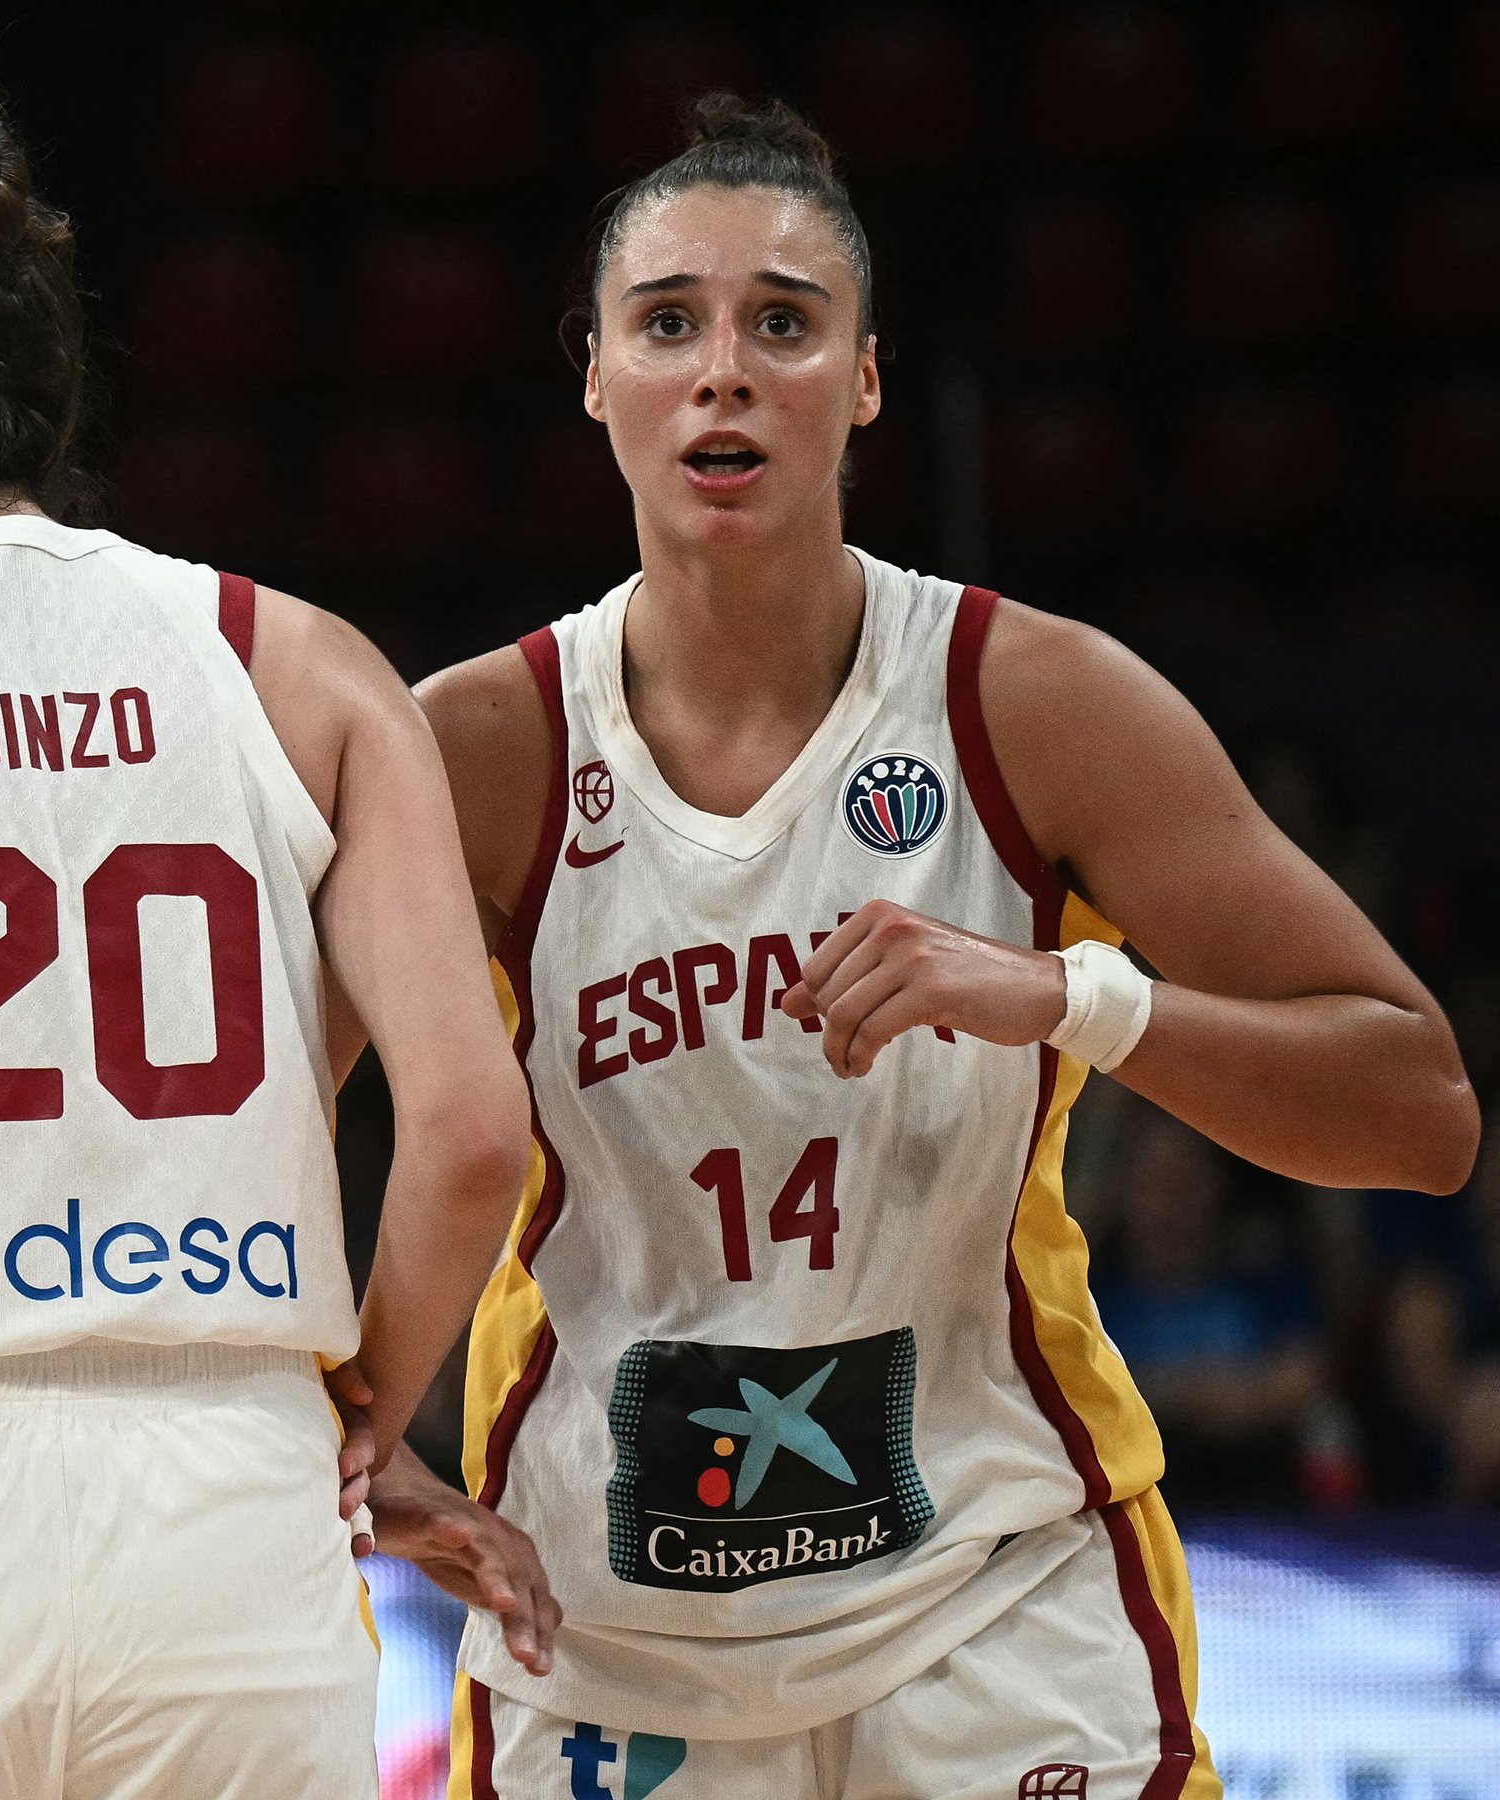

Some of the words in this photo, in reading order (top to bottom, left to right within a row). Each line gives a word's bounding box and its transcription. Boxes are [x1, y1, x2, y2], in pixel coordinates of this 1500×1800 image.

[857, 760, 925, 792] 2025
[578, 912, 956, 1090] ESPA
[689, 1136, 840, 1282] 14
[647, 1515, 892, 1578] CaixaBank
